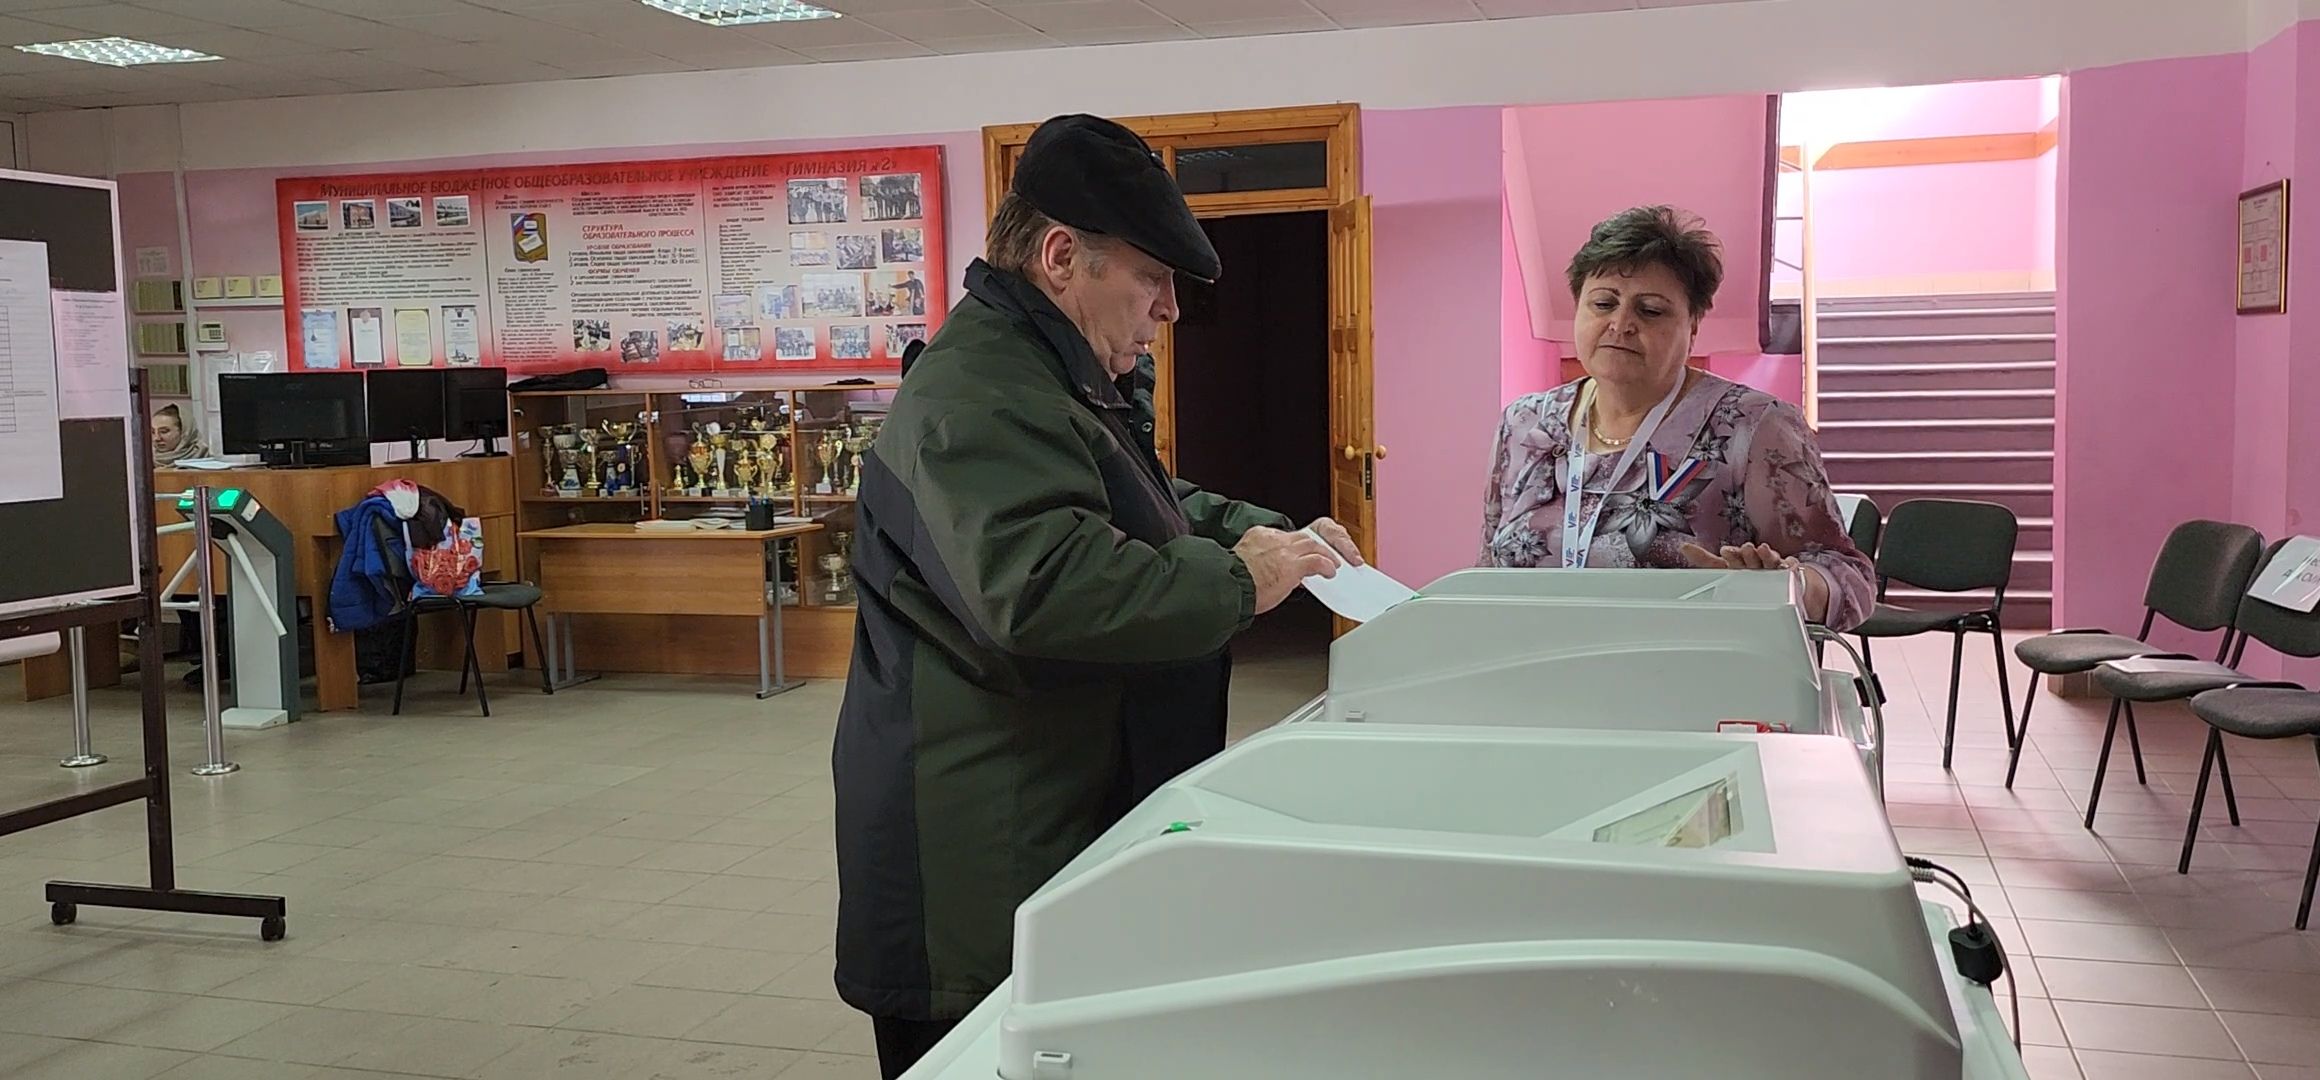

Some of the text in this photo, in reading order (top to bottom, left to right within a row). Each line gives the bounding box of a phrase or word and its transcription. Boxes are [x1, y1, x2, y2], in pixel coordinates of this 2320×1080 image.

[320, 180, 427, 198] МУНИЦИПАЛЬНОЕ
[430, 175, 511, 194] БЮДЖЕТНОЕ
[514, 169, 674, 190] ОБЩЕОБРАЗОВАТЕЛЬНОЕ
[677, 164, 770, 182] УЧРЕЖДЕНИЕ
[582, 224, 624, 233] СТРУКТУРА
[583, 228, 695, 240] ОБРАЗОВАТЕЛЬНОГО ПРОЦЕССА
